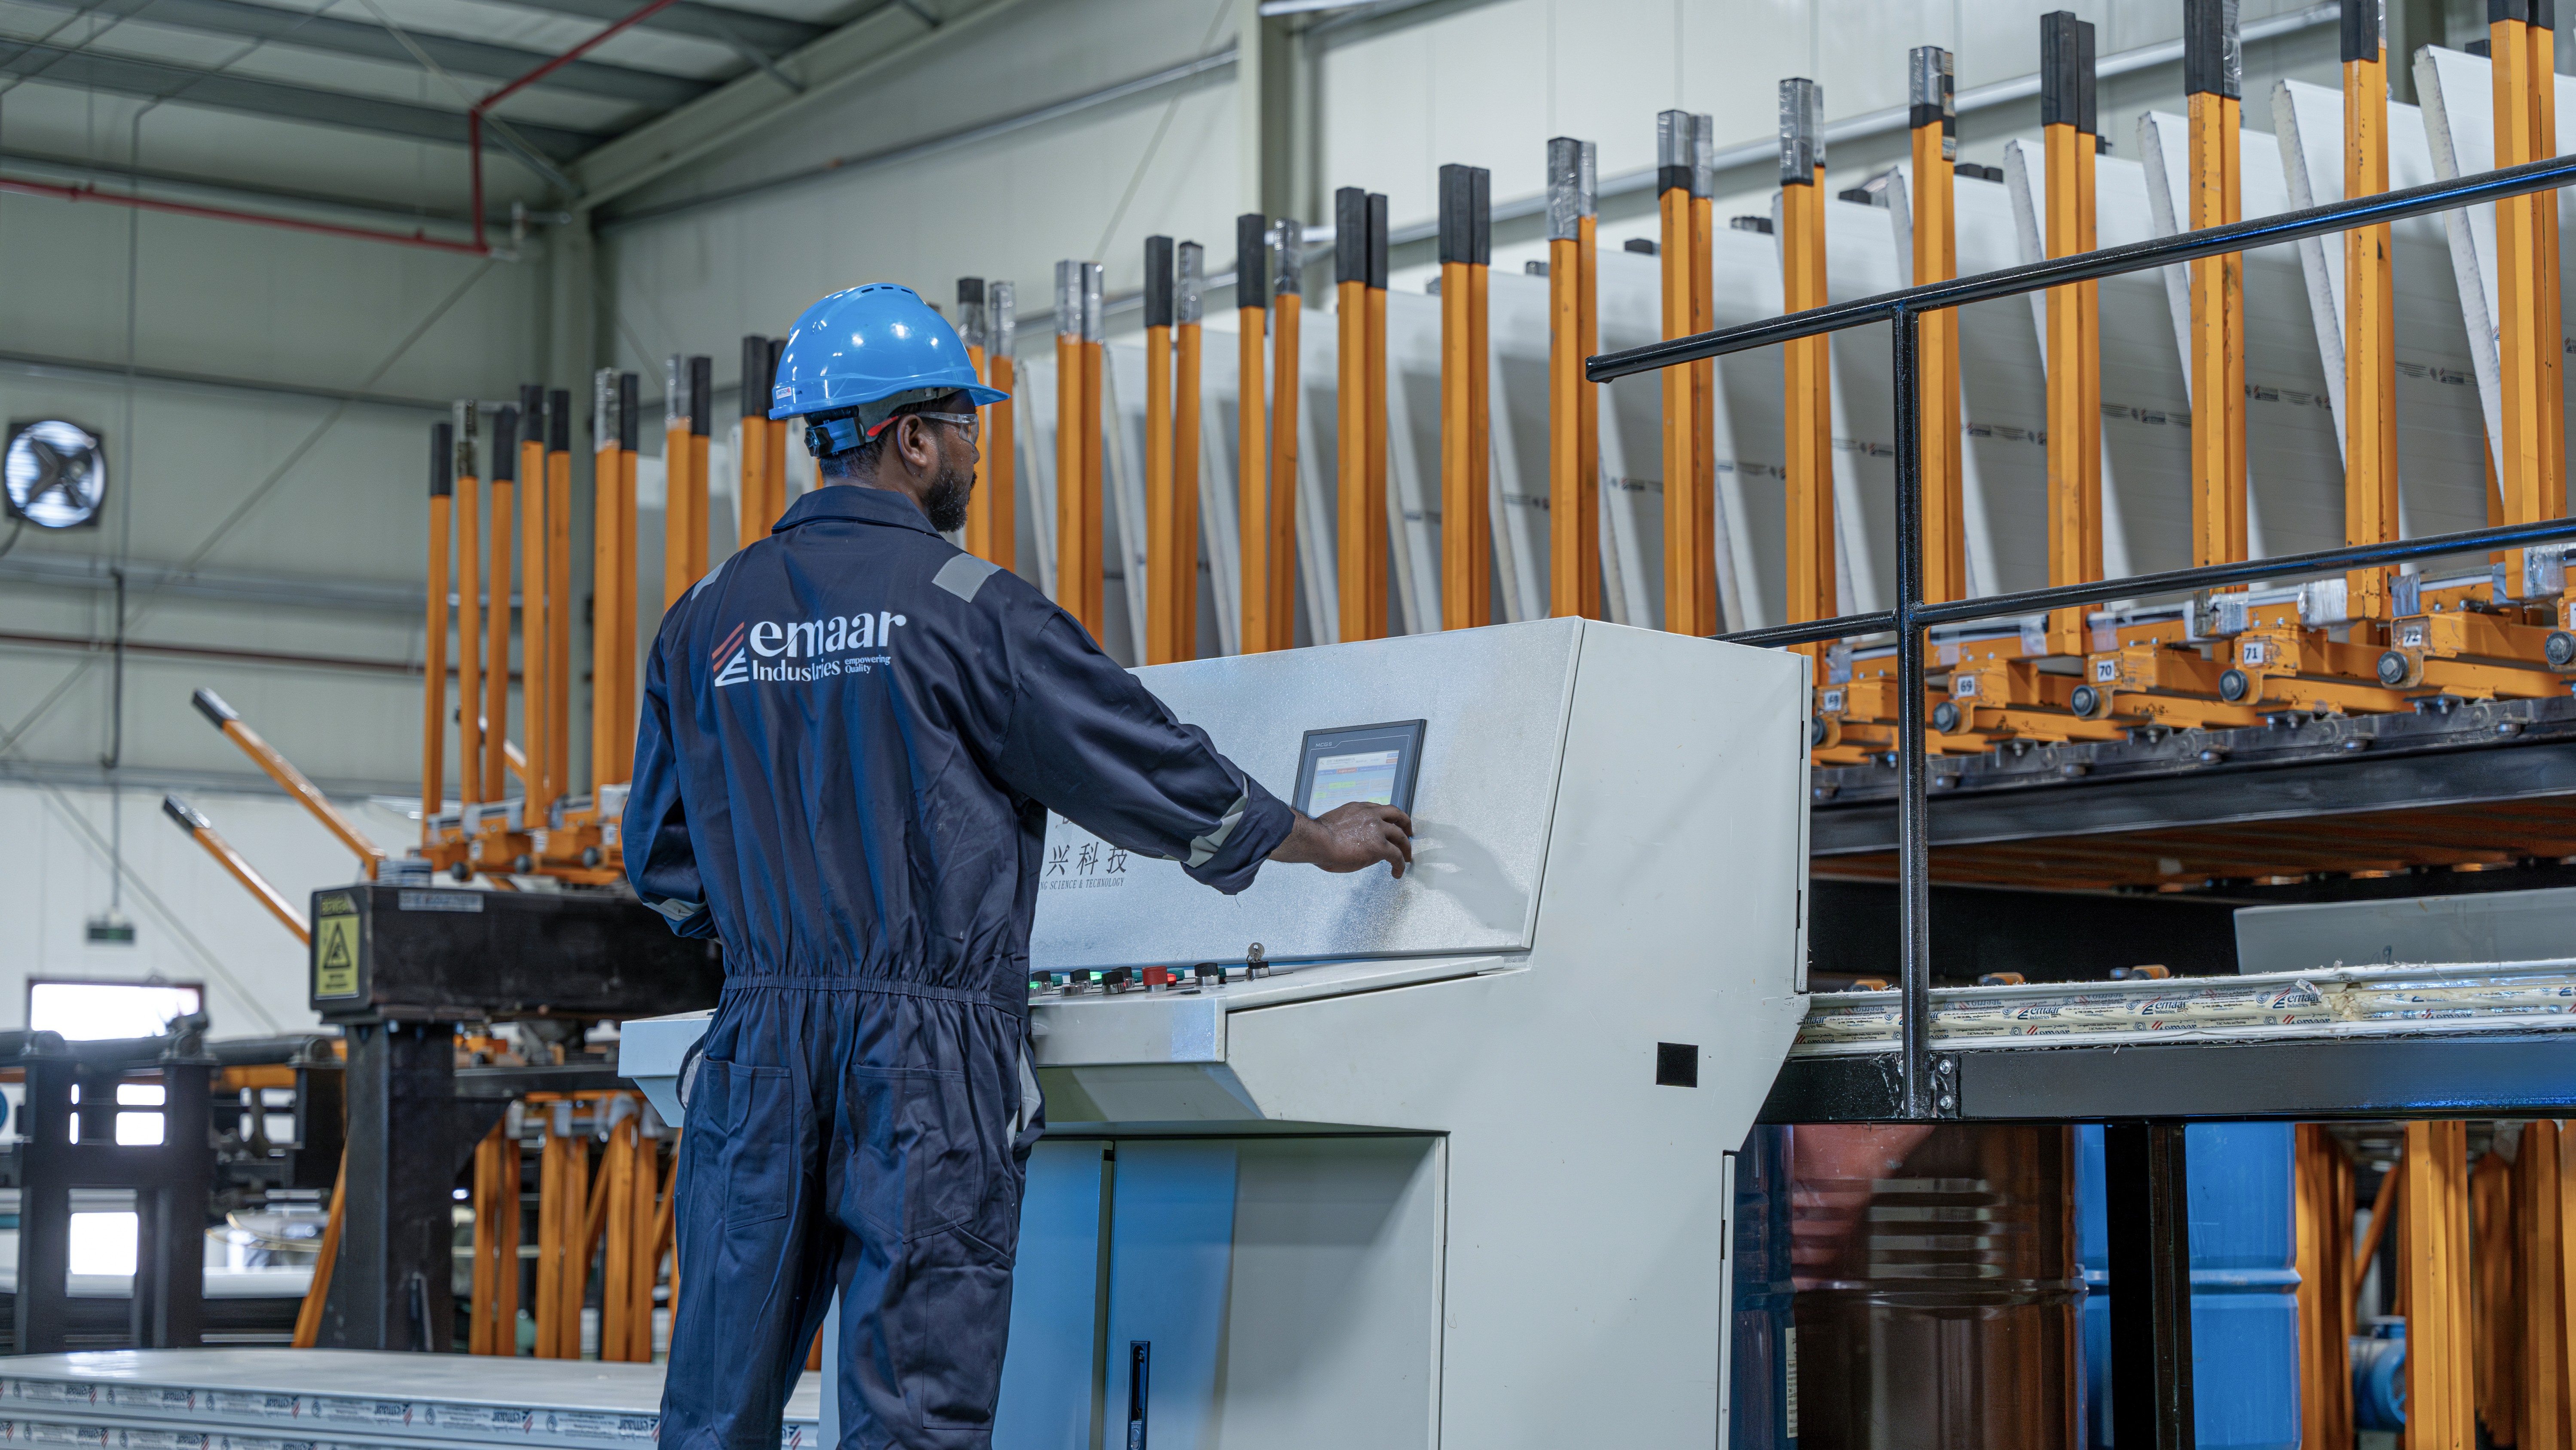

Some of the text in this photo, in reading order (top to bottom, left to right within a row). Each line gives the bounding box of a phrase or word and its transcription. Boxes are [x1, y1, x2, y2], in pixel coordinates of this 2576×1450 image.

[750, 611, 906, 657] emaar
[2245, 647, 2258, 660] 71
[844, 655, 890, 665] empowering
[753, 659, 840, 681] Industries
[845, 664, 871, 674] Quality
[2099, 665, 2111, 677] 70
[1960, 678, 1973, 692] 69
[1049, 880, 1076, 890] SCIENCE
[1078, 880, 1083, 889] &
[1086, 877, 1125, 888] TECHNOLOGY
[2155, 1001, 2189, 1009] emaar
[1804, 1017, 1827, 1025] maar
